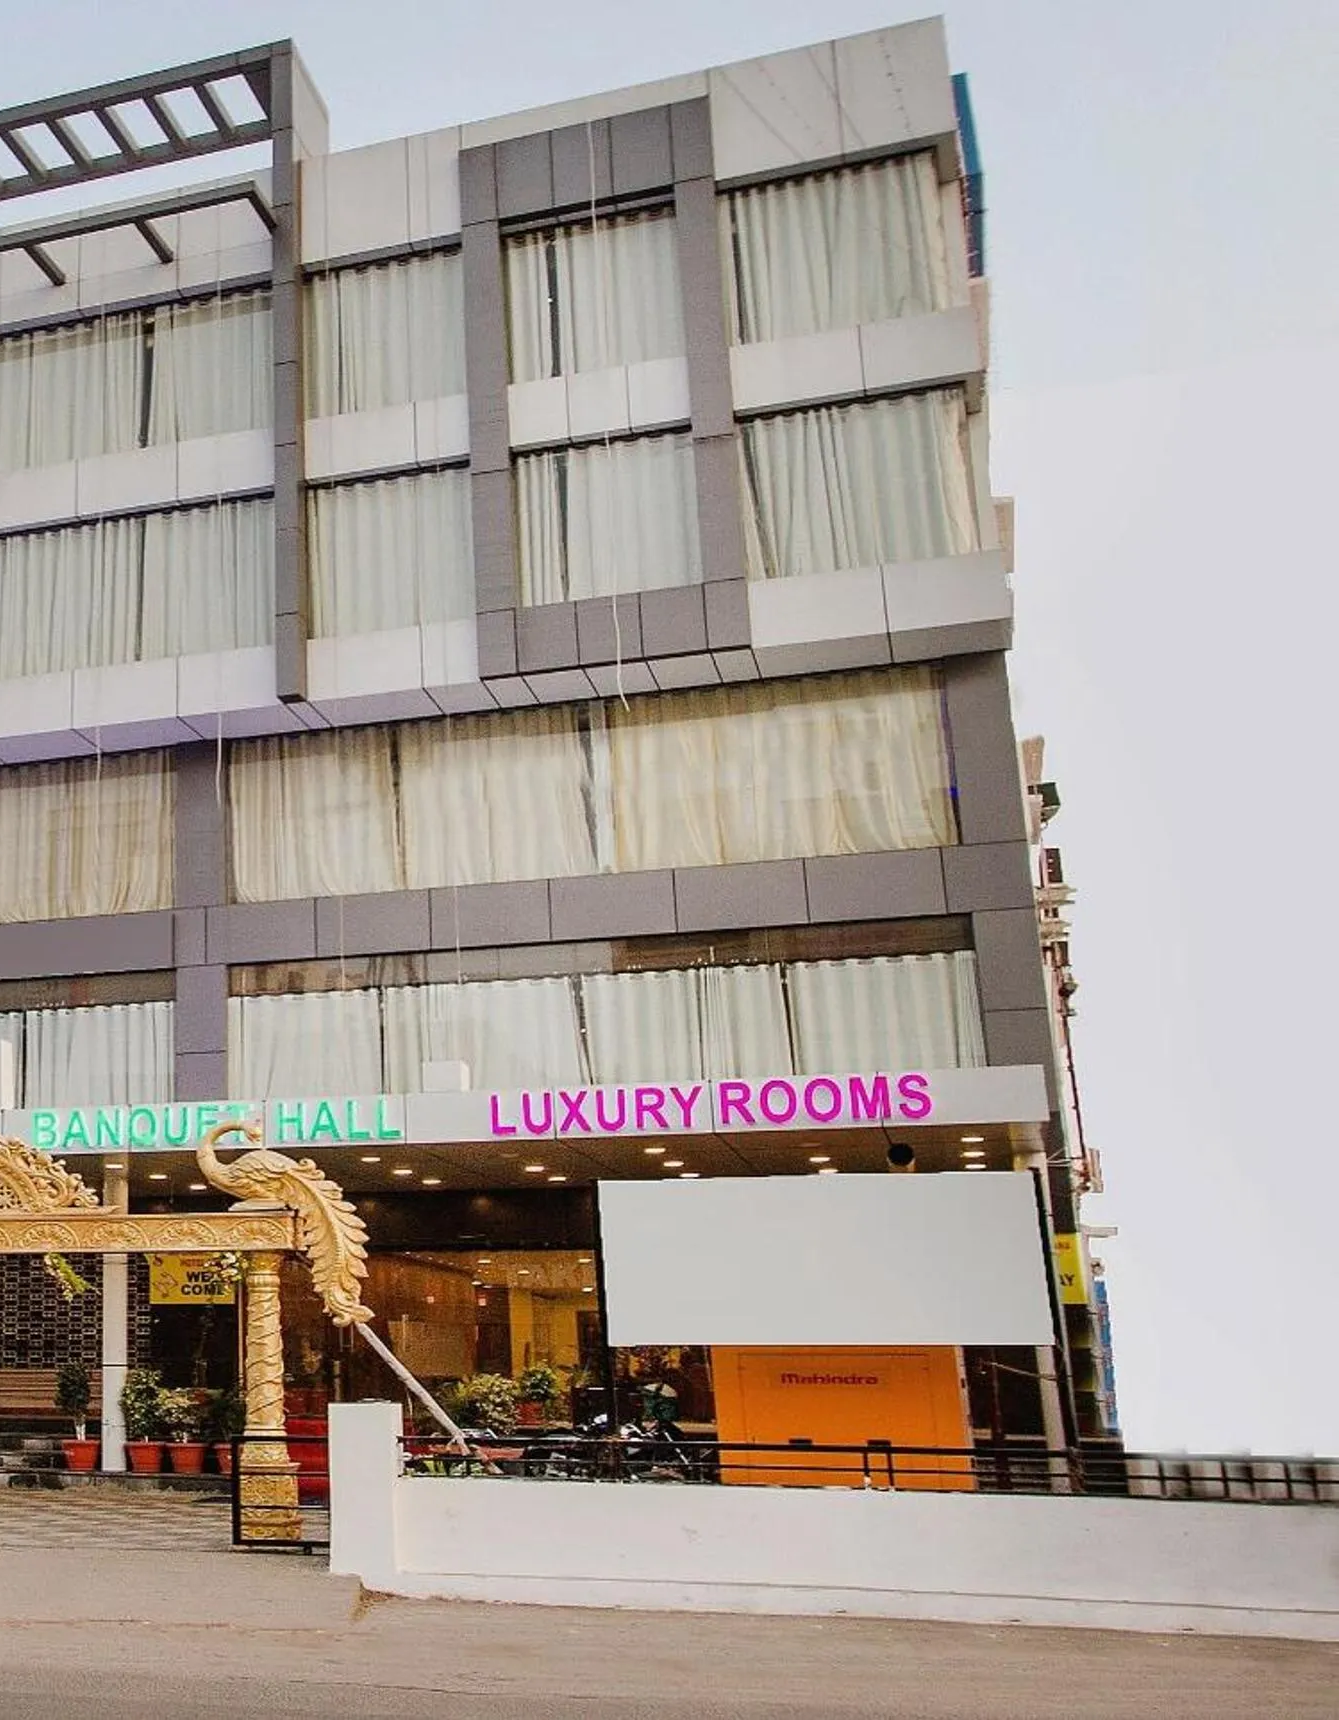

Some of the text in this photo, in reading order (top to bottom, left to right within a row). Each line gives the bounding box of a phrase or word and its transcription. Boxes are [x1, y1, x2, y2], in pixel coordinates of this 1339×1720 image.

[276, 1101, 402, 1141] HALL
[490, 1073, 934, 1136] LUXURY ROOMS
